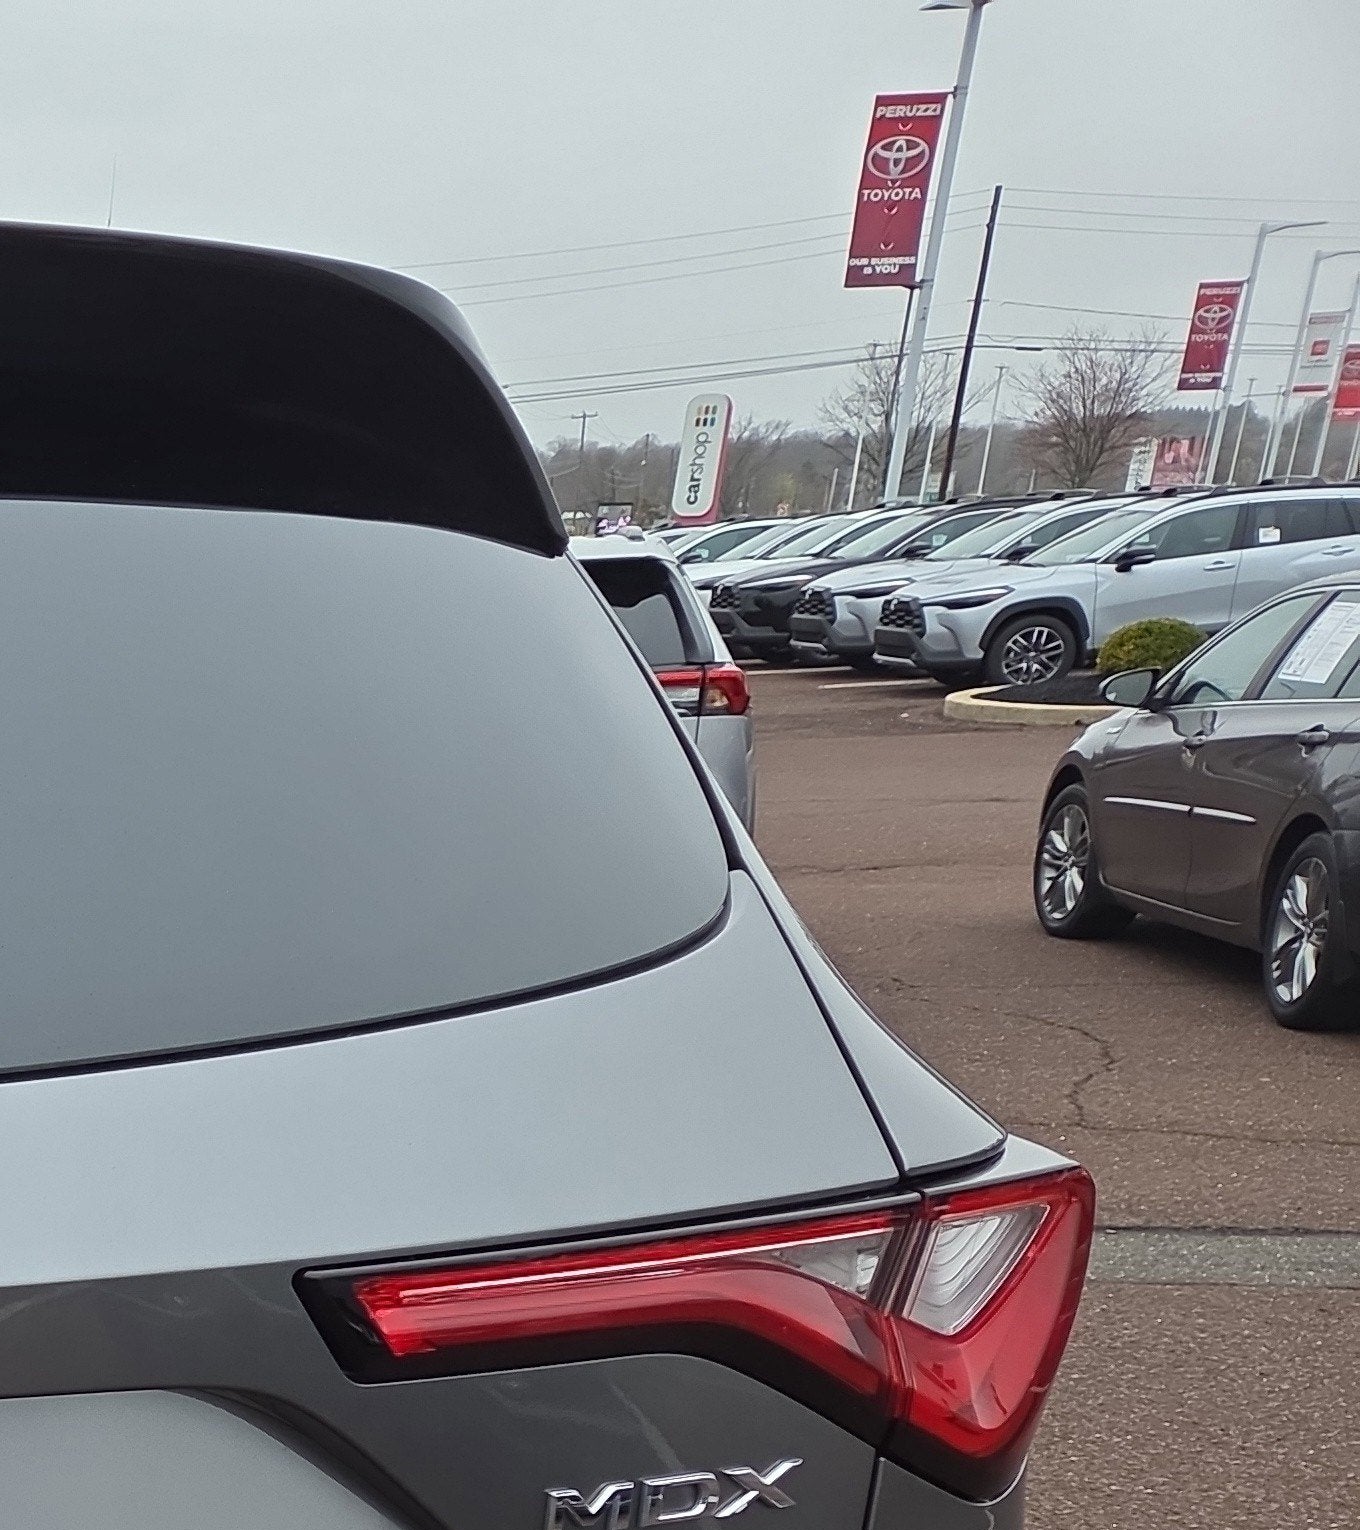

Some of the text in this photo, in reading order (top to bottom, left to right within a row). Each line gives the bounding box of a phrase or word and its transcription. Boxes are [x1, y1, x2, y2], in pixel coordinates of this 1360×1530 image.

[876, 103, 941, 119] PERUZZI
[862, 188, 922, 202] TOYOTA
[849, 257, 870, 266] OUR
[874, 264, 900, 274] YOU
[1190, 333, 1229, 343] TOYOTA
[686, 431, 712, 506] carshop
